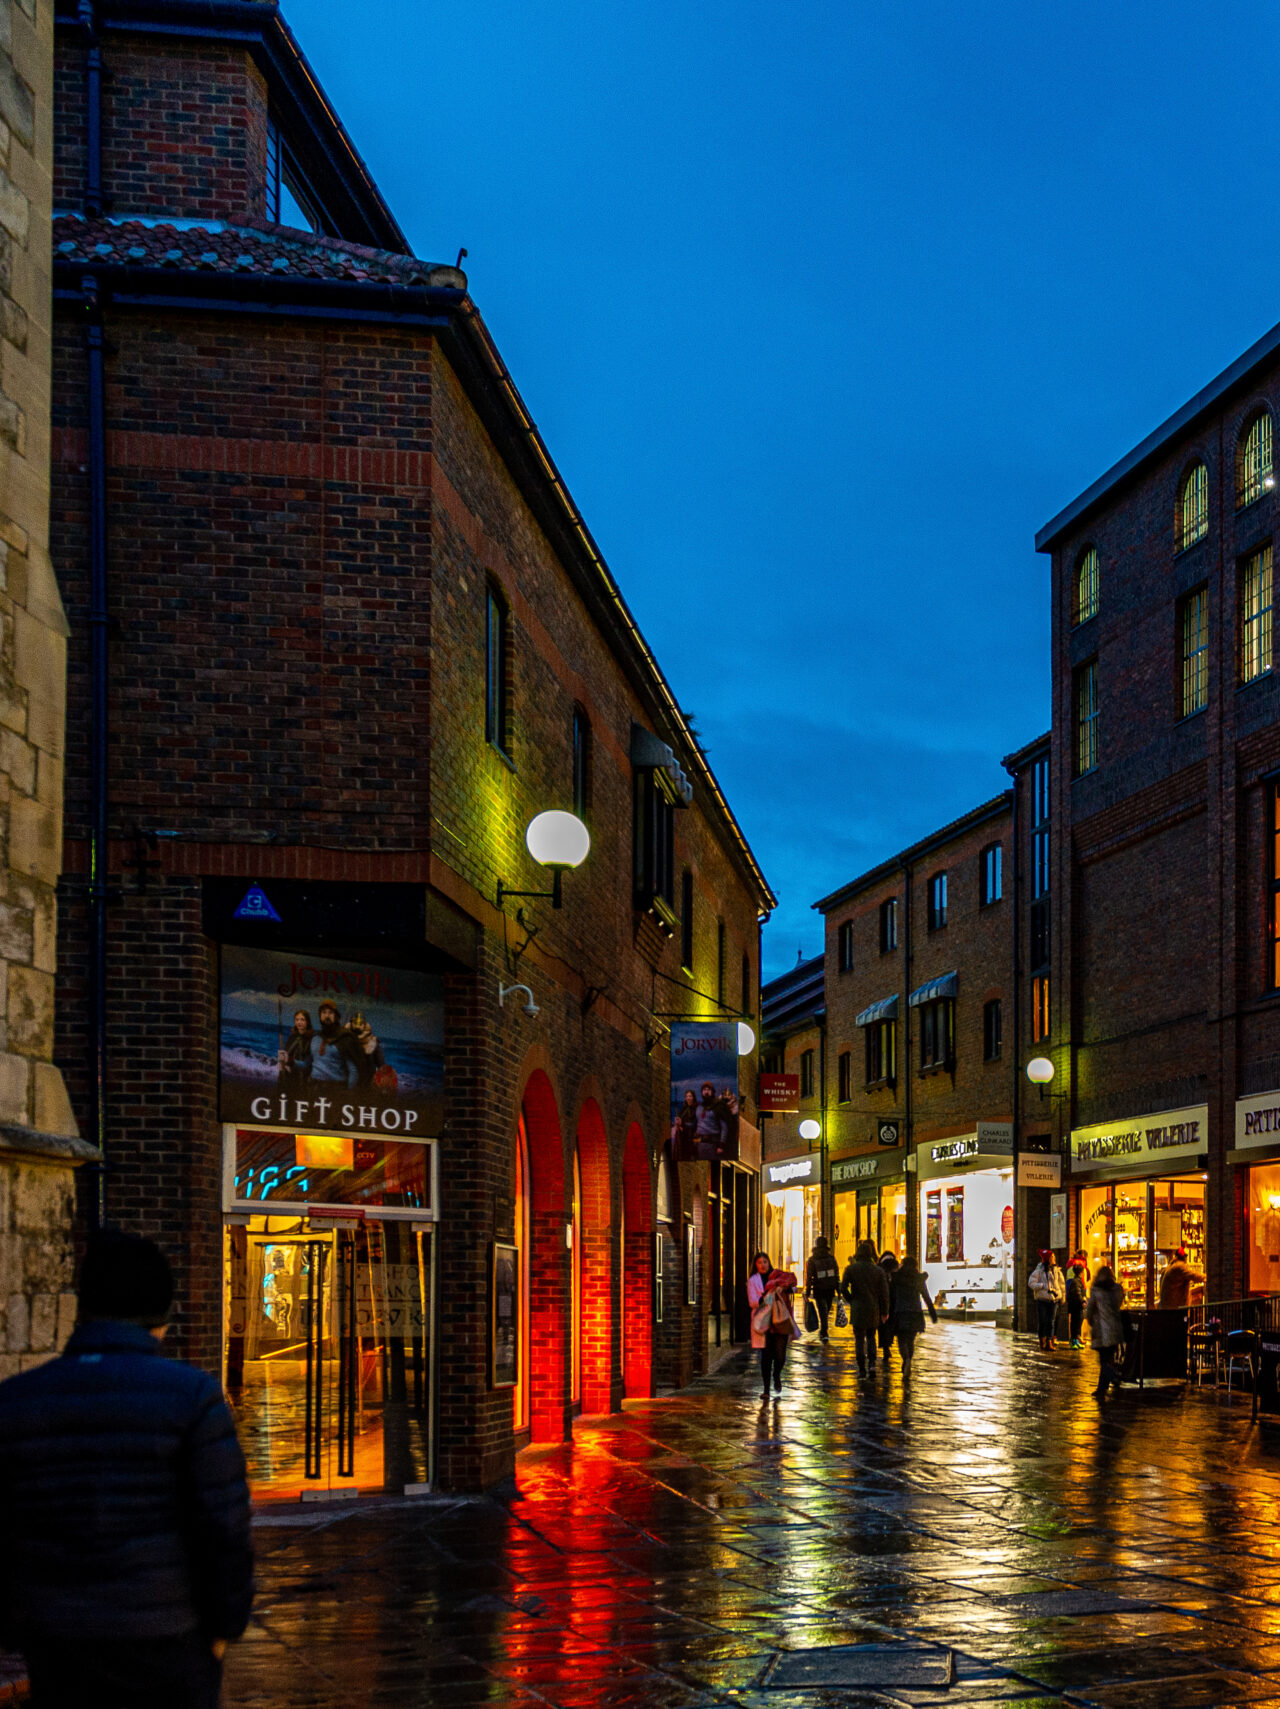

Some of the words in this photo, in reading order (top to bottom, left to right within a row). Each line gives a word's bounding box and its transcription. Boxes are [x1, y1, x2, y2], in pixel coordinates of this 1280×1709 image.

[341, 1104, 419, 1131] SHOP
[1077, 1131, 1142, 1161] PATISSERIE
[1145, 1121, 1200, 1150] VALERIE
[832, 1167, 843, 1181] THE
[860, 1160, 877, 1176] SHOP
